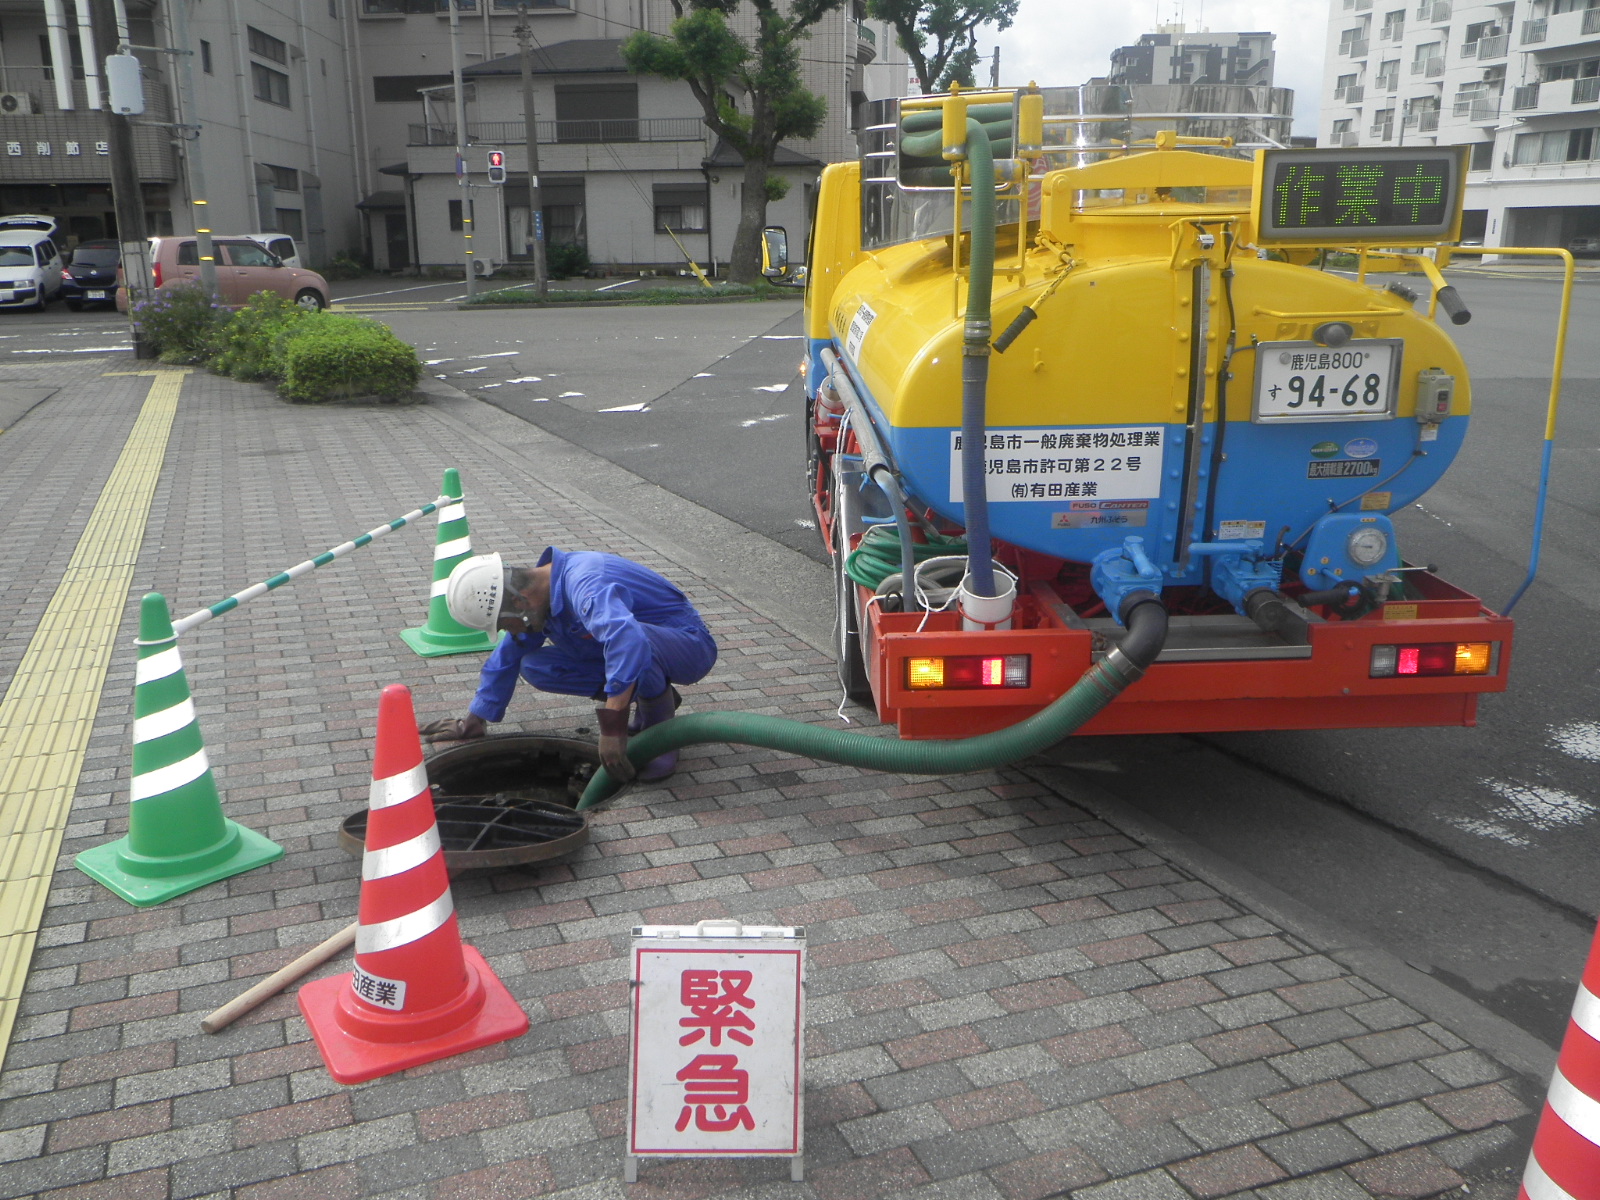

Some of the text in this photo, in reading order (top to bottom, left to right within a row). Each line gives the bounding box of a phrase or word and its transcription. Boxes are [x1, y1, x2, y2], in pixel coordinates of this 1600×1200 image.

[1276, 164, 1443, 225] 作業中
[1290, 352, 1363, 371] 鹿児島800
[1267, 373, 1381, 408] す 94-68
[954, 431, 1160, 451] 島市一般廃棄物処理業
[984, 456, 1142, 475] 児島市許可第22号
[1100, 501, 1147, 509] CANTER
[674, 969, 756, 1132] 緊急
